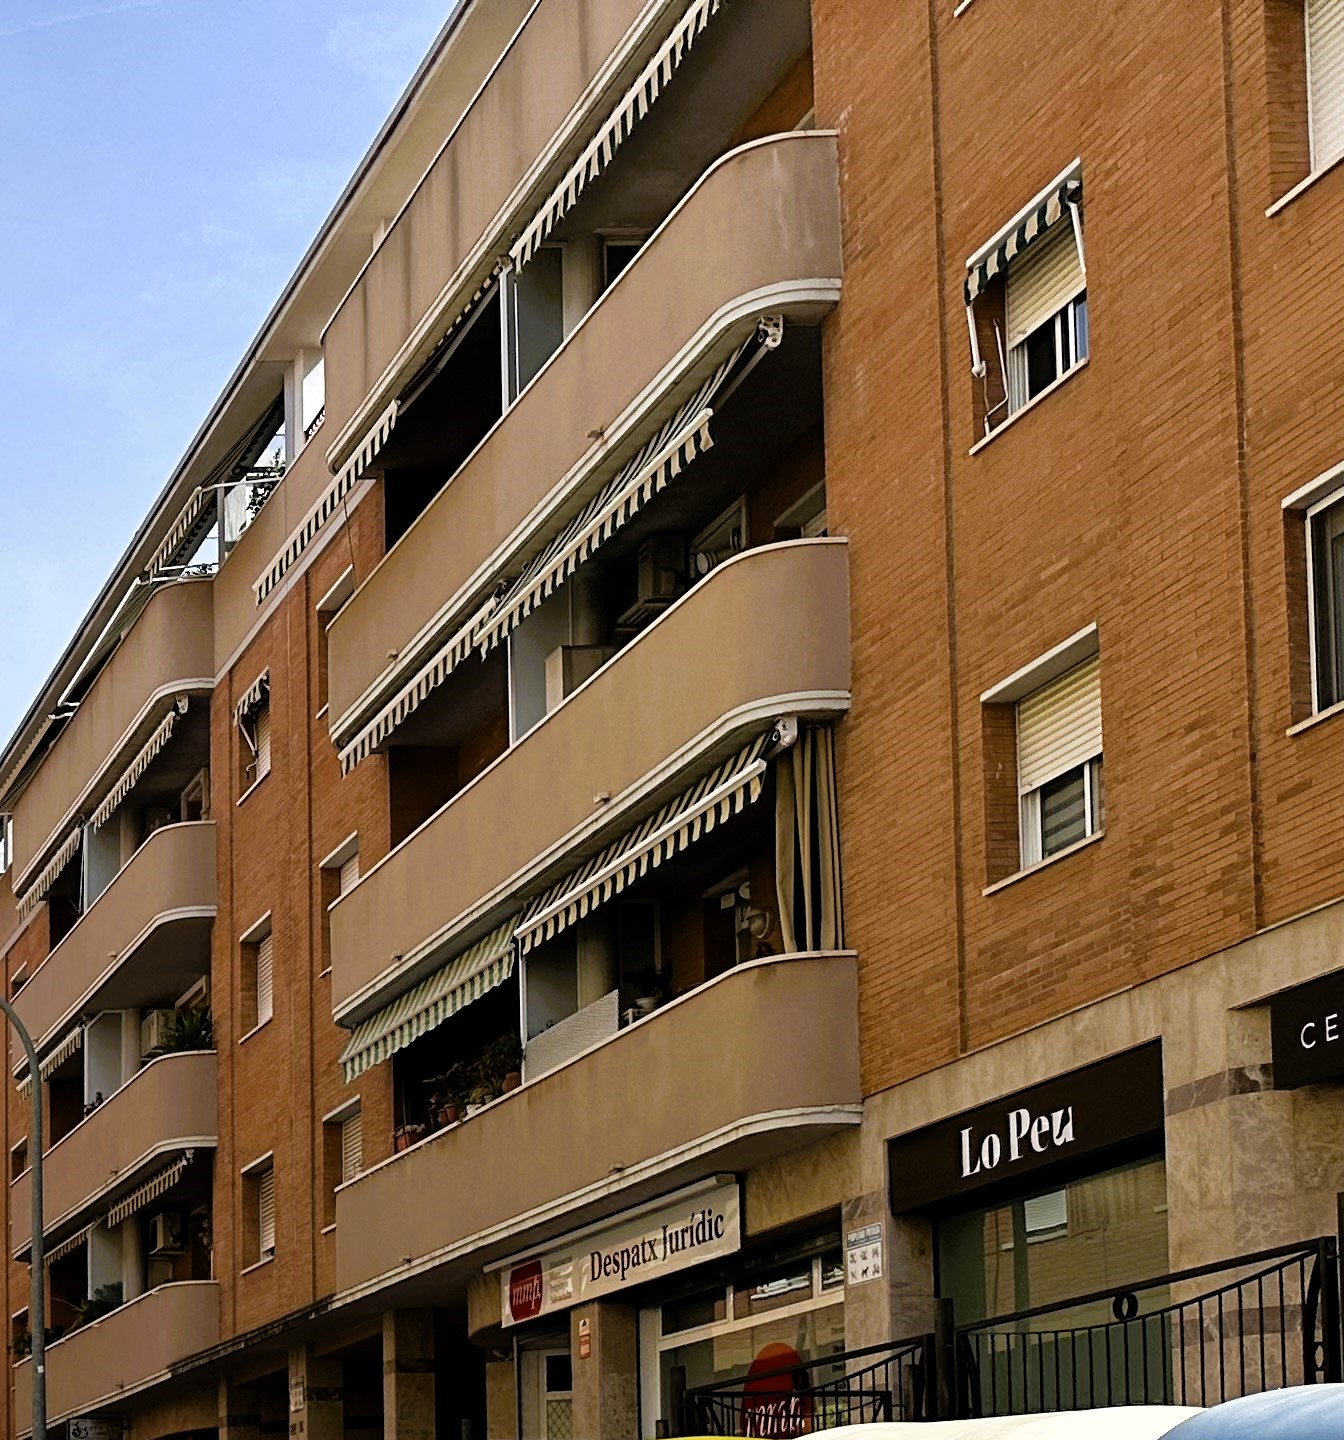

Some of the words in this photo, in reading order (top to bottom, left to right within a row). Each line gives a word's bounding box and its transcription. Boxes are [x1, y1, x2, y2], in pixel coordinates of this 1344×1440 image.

[960, 1127, 1001, 1178] Lo
[1007, 1105, 1075, 1162] Peu
[590, 1237, 658, 1281] Despatx
[662, 1208, 725, 1262] Jurídic
